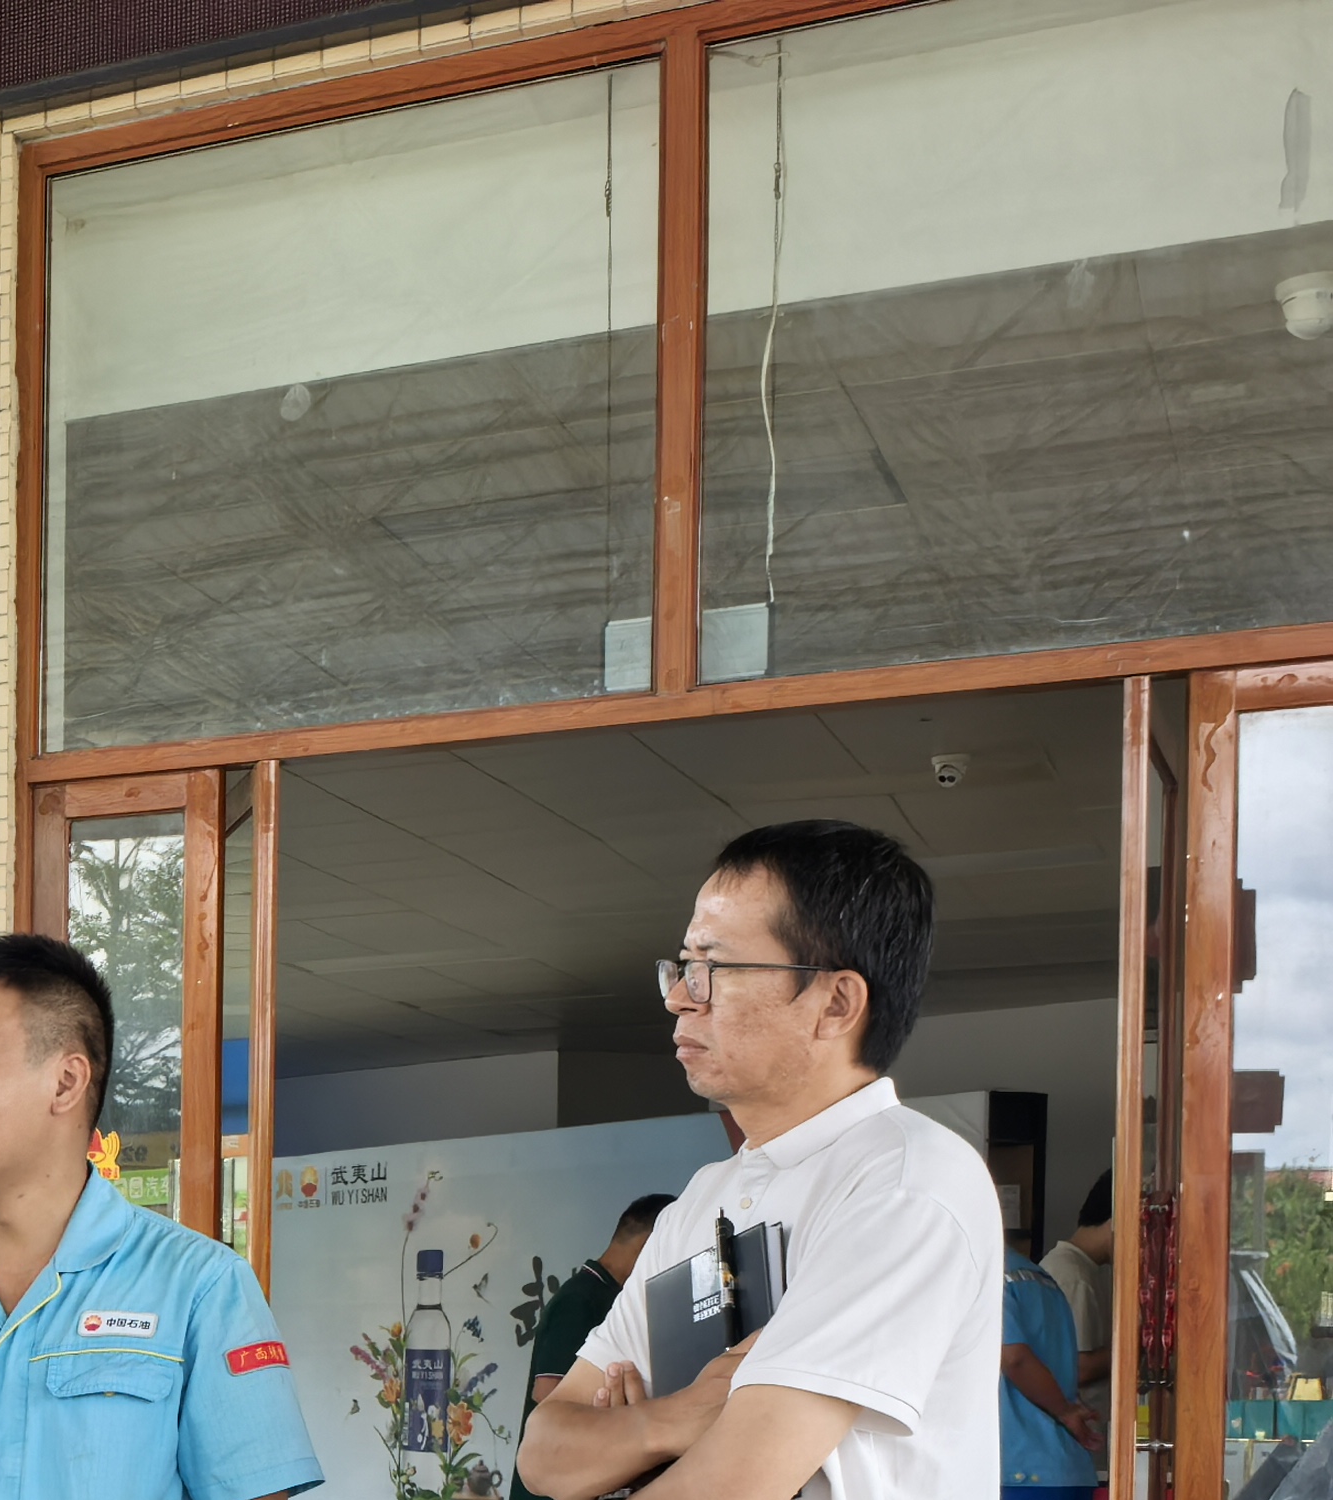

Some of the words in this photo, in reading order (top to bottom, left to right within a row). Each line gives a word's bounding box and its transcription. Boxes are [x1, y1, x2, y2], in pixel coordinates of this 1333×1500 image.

[331, 1161, 388, 1185] 武夷山
[106, 1317, 151, 1330] 中国石油
